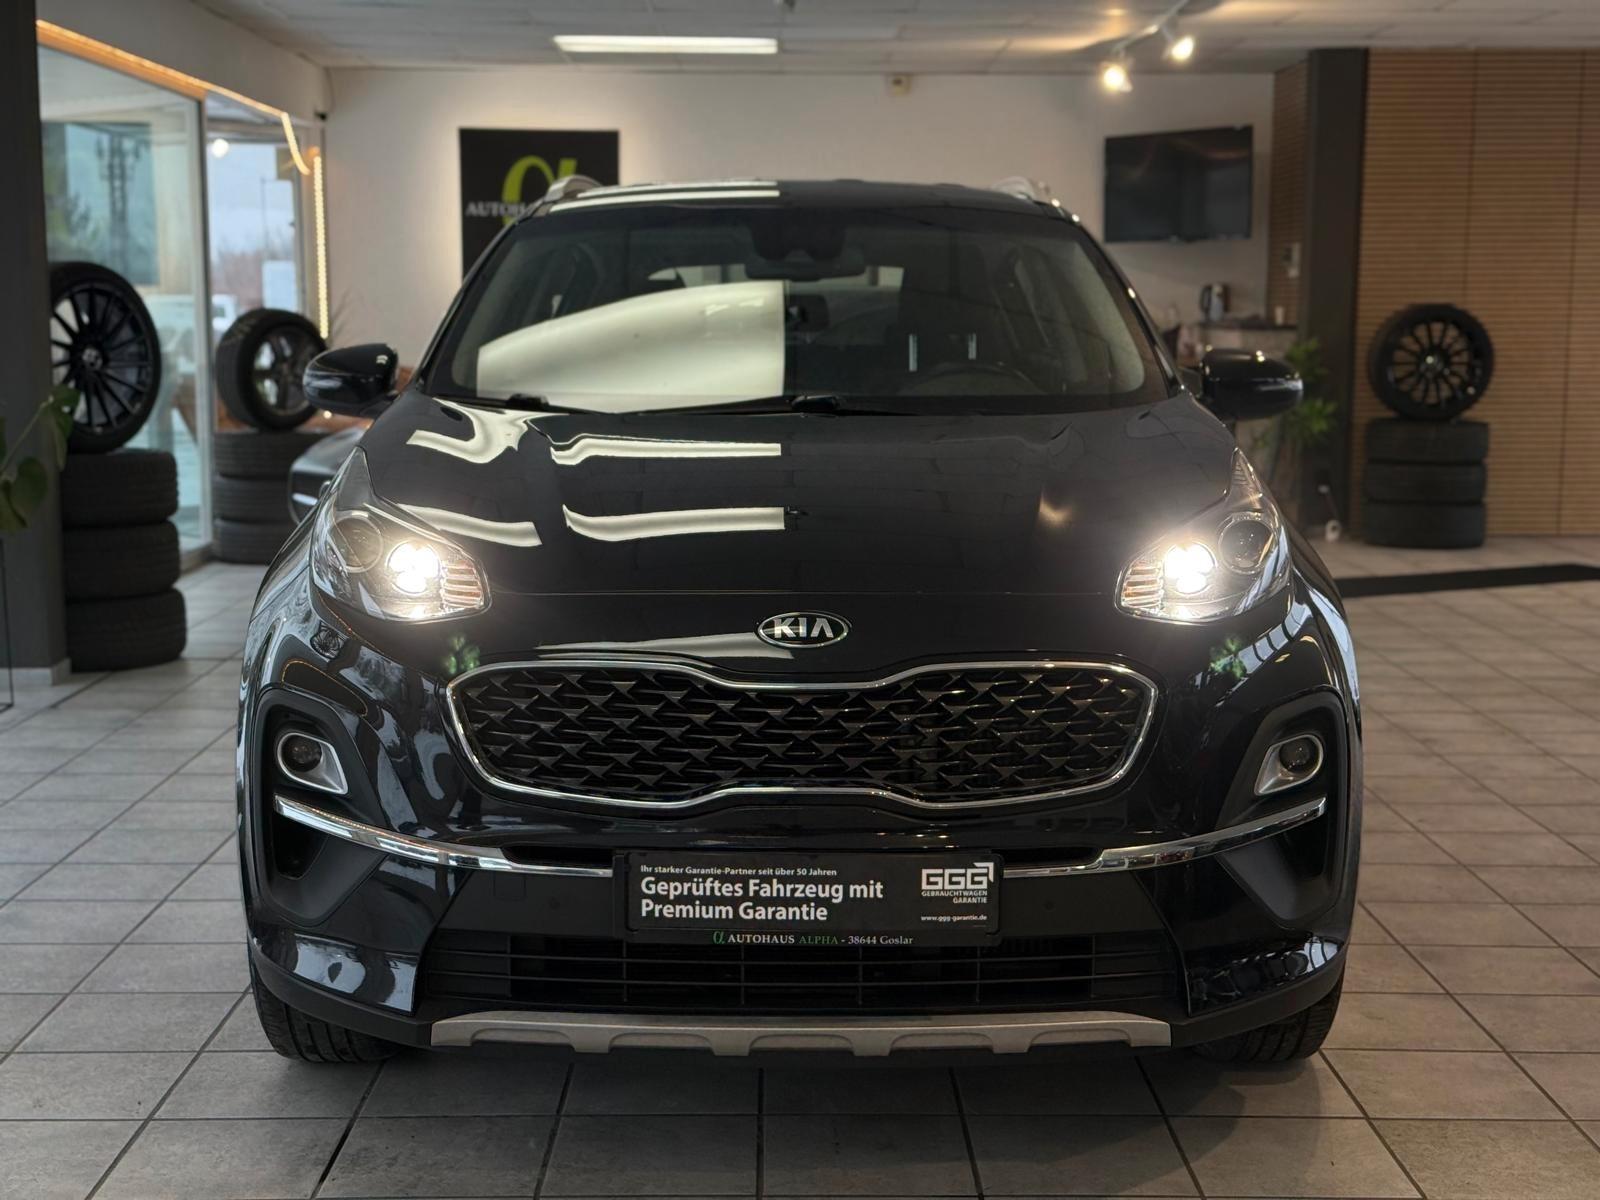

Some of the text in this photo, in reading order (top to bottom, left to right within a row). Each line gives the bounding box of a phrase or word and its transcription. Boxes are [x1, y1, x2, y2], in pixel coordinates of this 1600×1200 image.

[773, 617, 834, 639] KIA
[640, 865, 837, 876] Ihr starker Garantie-Partner seit über 50 Jahren
[921, 868, 988, 890] GGG
[640, 876, 884, 903] Geprüftes Fahrzeug mit
[952, 896, 988, 904] GARANTIE
[641, 898, 828, 921] Premium Garantie
[920, 914, 988, 923] www.ggg-garantie.de
[728, 934, 795, 944] AUTOHAUS
[799, 936, 839, 945] ALPHA
[848, 936, 877, 944] 38644
[879, 936, 914, 945] Goslar
